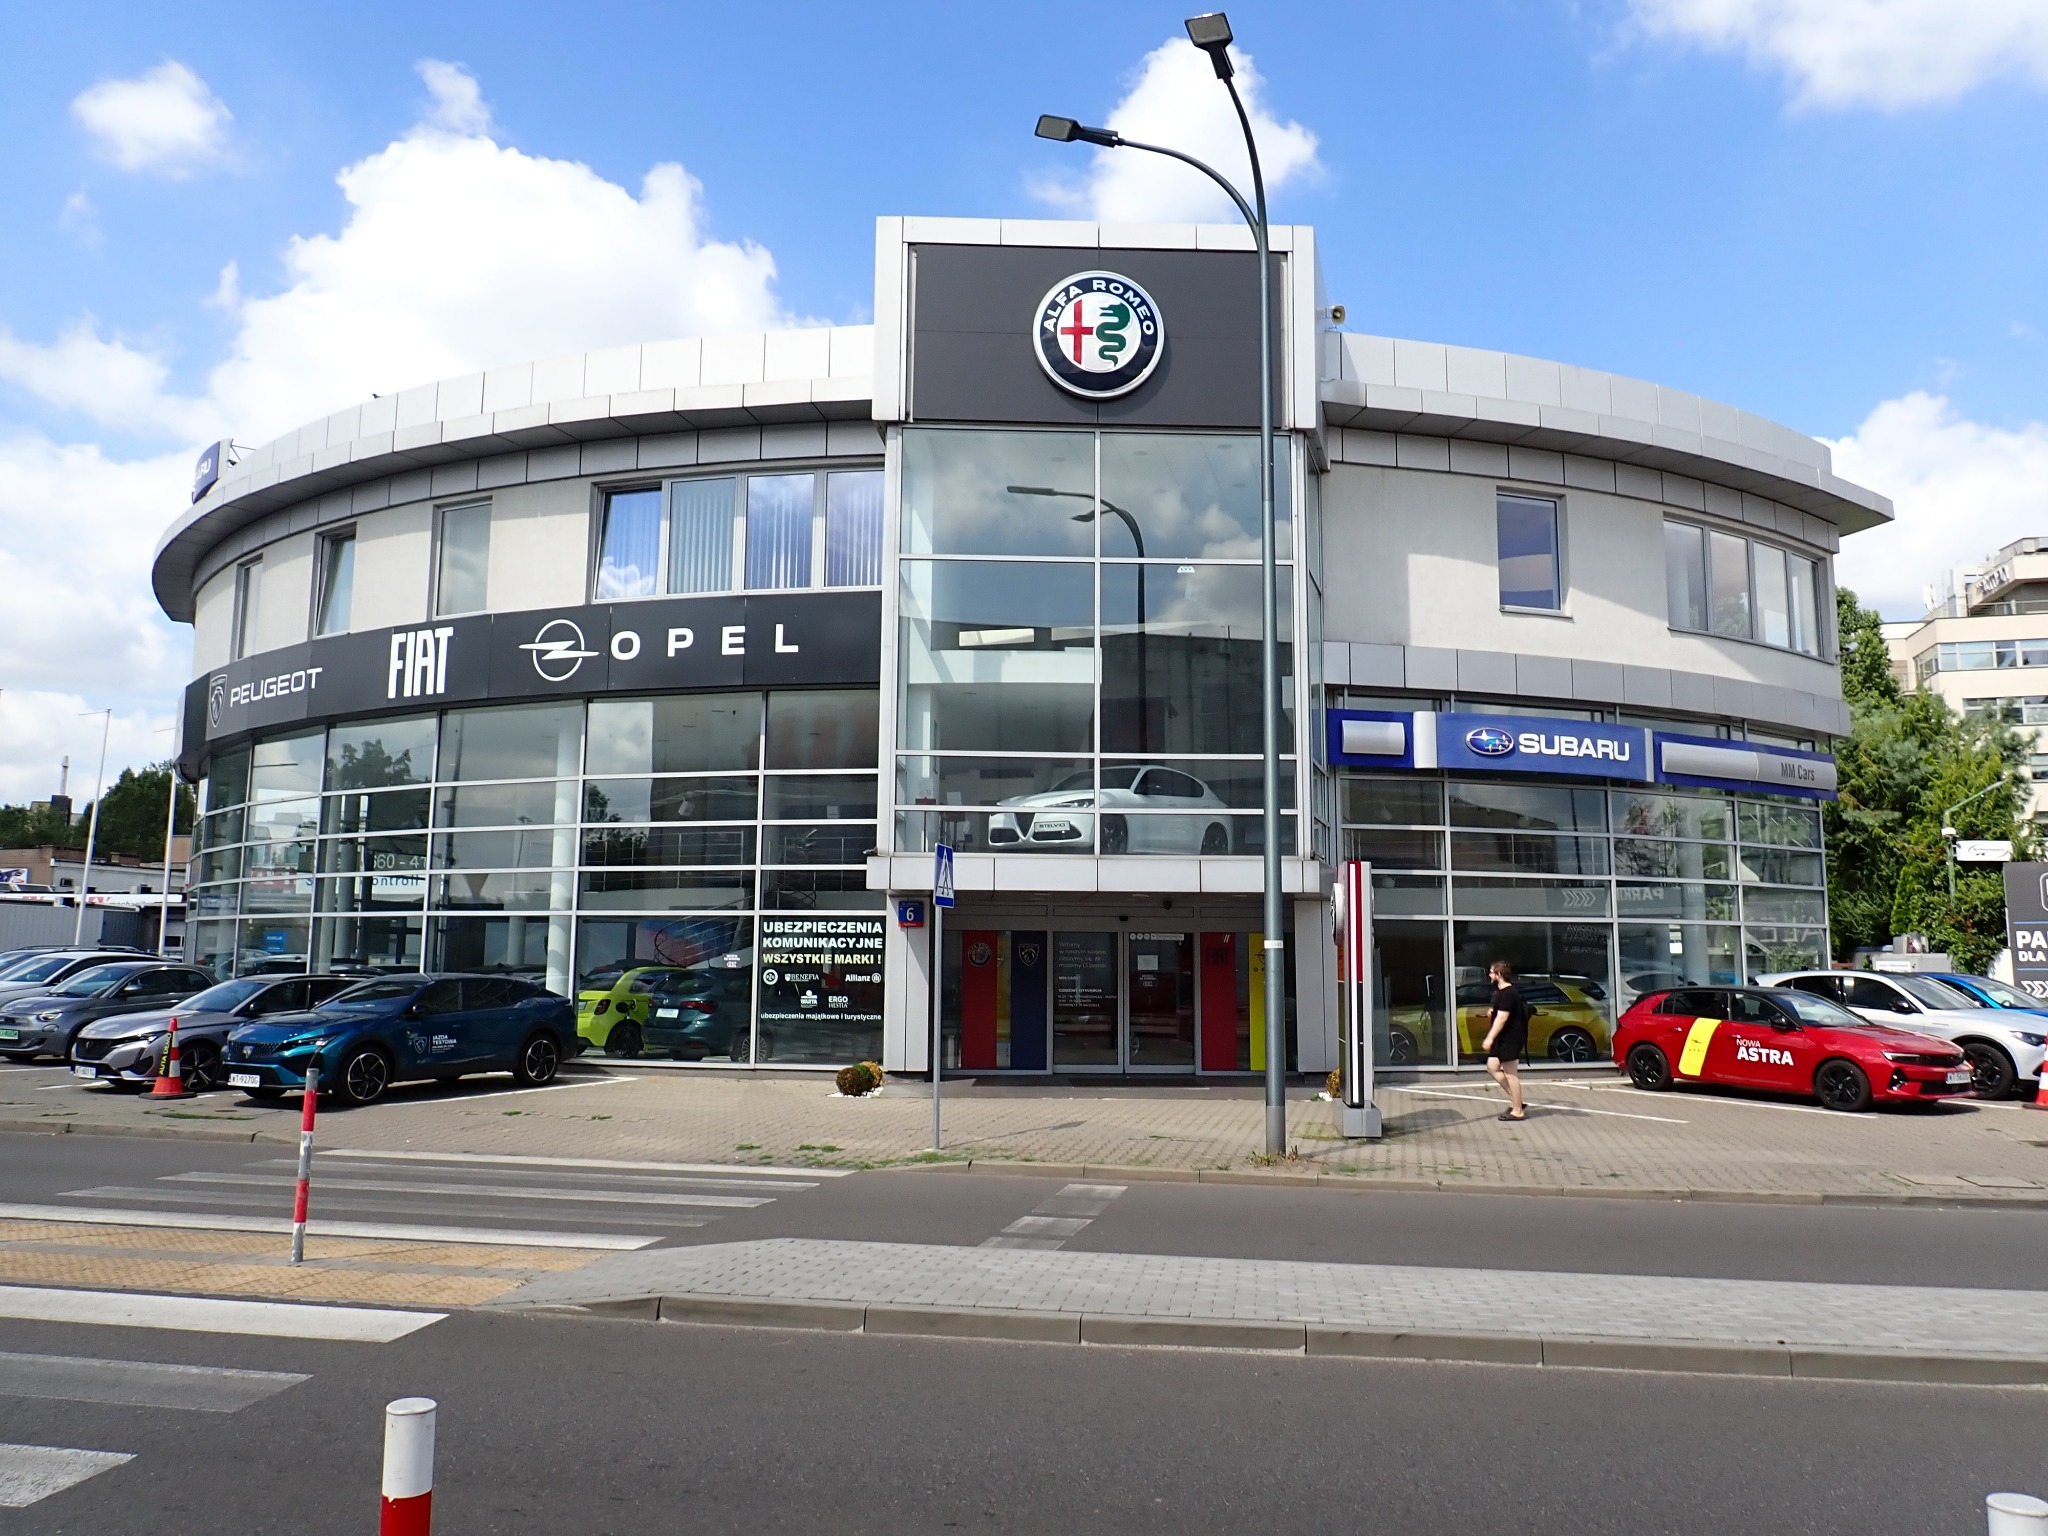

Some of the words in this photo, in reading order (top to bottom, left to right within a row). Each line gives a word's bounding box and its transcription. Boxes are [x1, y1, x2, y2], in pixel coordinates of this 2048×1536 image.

[1043, 285, 1083, 333] ALFA
[1092, 279, 1155, 335] ROMEO
[610, 624, 799, 660] OPEL
[388, 627, 453, 699] FIAT
[230, 667, 323, 707] PEUGEOT
[1518, 733, 1630, 762] SUBARU
[1781, 762, 1795, 778] MM
[1797, 764, 1815, 781] Cars
[906, 907, 915, 922] 6
[763, 921, 884, 934] UBEZPIECZENIA
[762, 937, 883, 949] KOMUNIKACYJNE
[2015, 930, 2048, 949] PA
[762, 953, 833, 965] WSZYSTKIE
[834, 954, 874, 965] MARKI
[2018, 951, 2046, 962] DLA
[791, 973, 820, 981] BENEFIA
[845, 974, 871, 982] Allianz
[760, 1012, 805, 1020] ubezpieczenia
[805, 1013, 840, 1021] majątkowe
[844, 1013, 882, 1021] turystyczne
[1736, 1038, 1761, 1048] NOWA
[1737, 1047, 1794, 1066] ASTRA
[159, 1055, 168, 1076] AUTA
